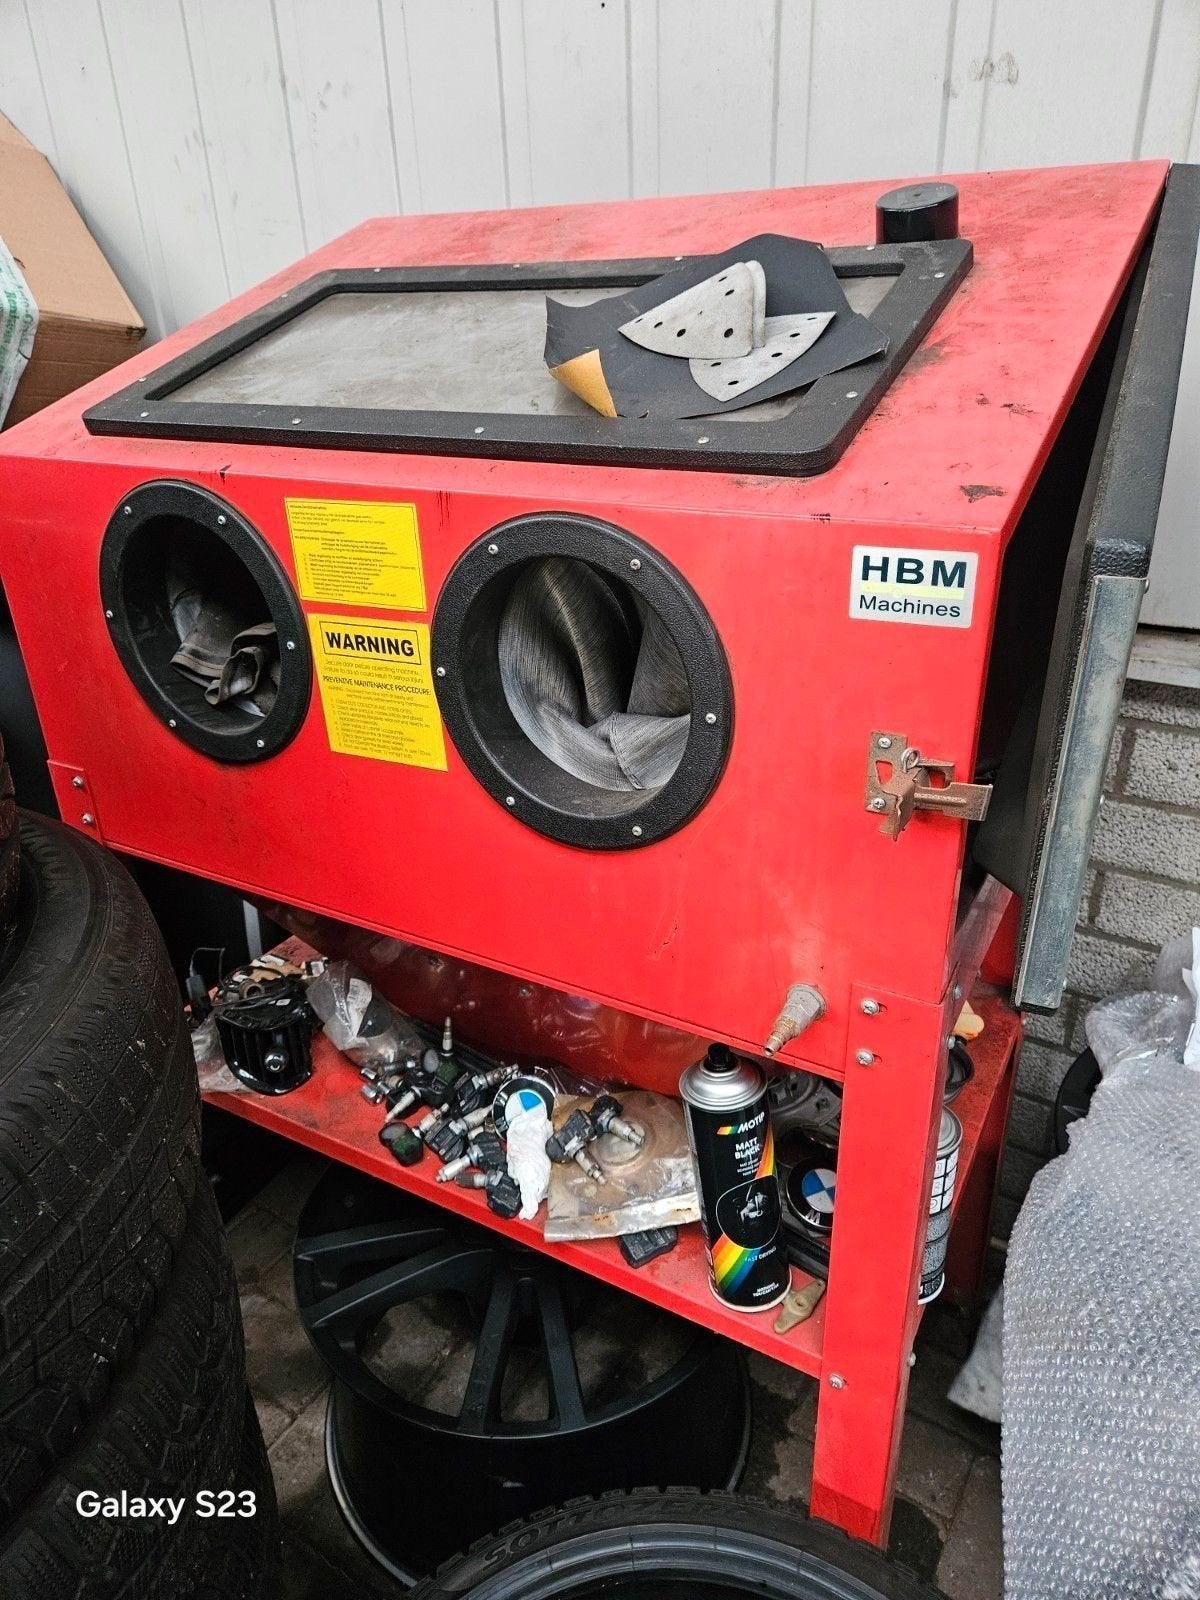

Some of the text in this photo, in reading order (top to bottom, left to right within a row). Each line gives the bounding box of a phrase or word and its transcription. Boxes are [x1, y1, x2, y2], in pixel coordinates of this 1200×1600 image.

[861, 555, 967, 588] HBM
[859, 594, 961, 618] Machines
[325, 631, 415, 657] WARNING
[737, 1111, 765, 1134] MOTIP
[734, 1144, 760, 1160] BLACK
[735, 1136, 758, 1152] MATT
